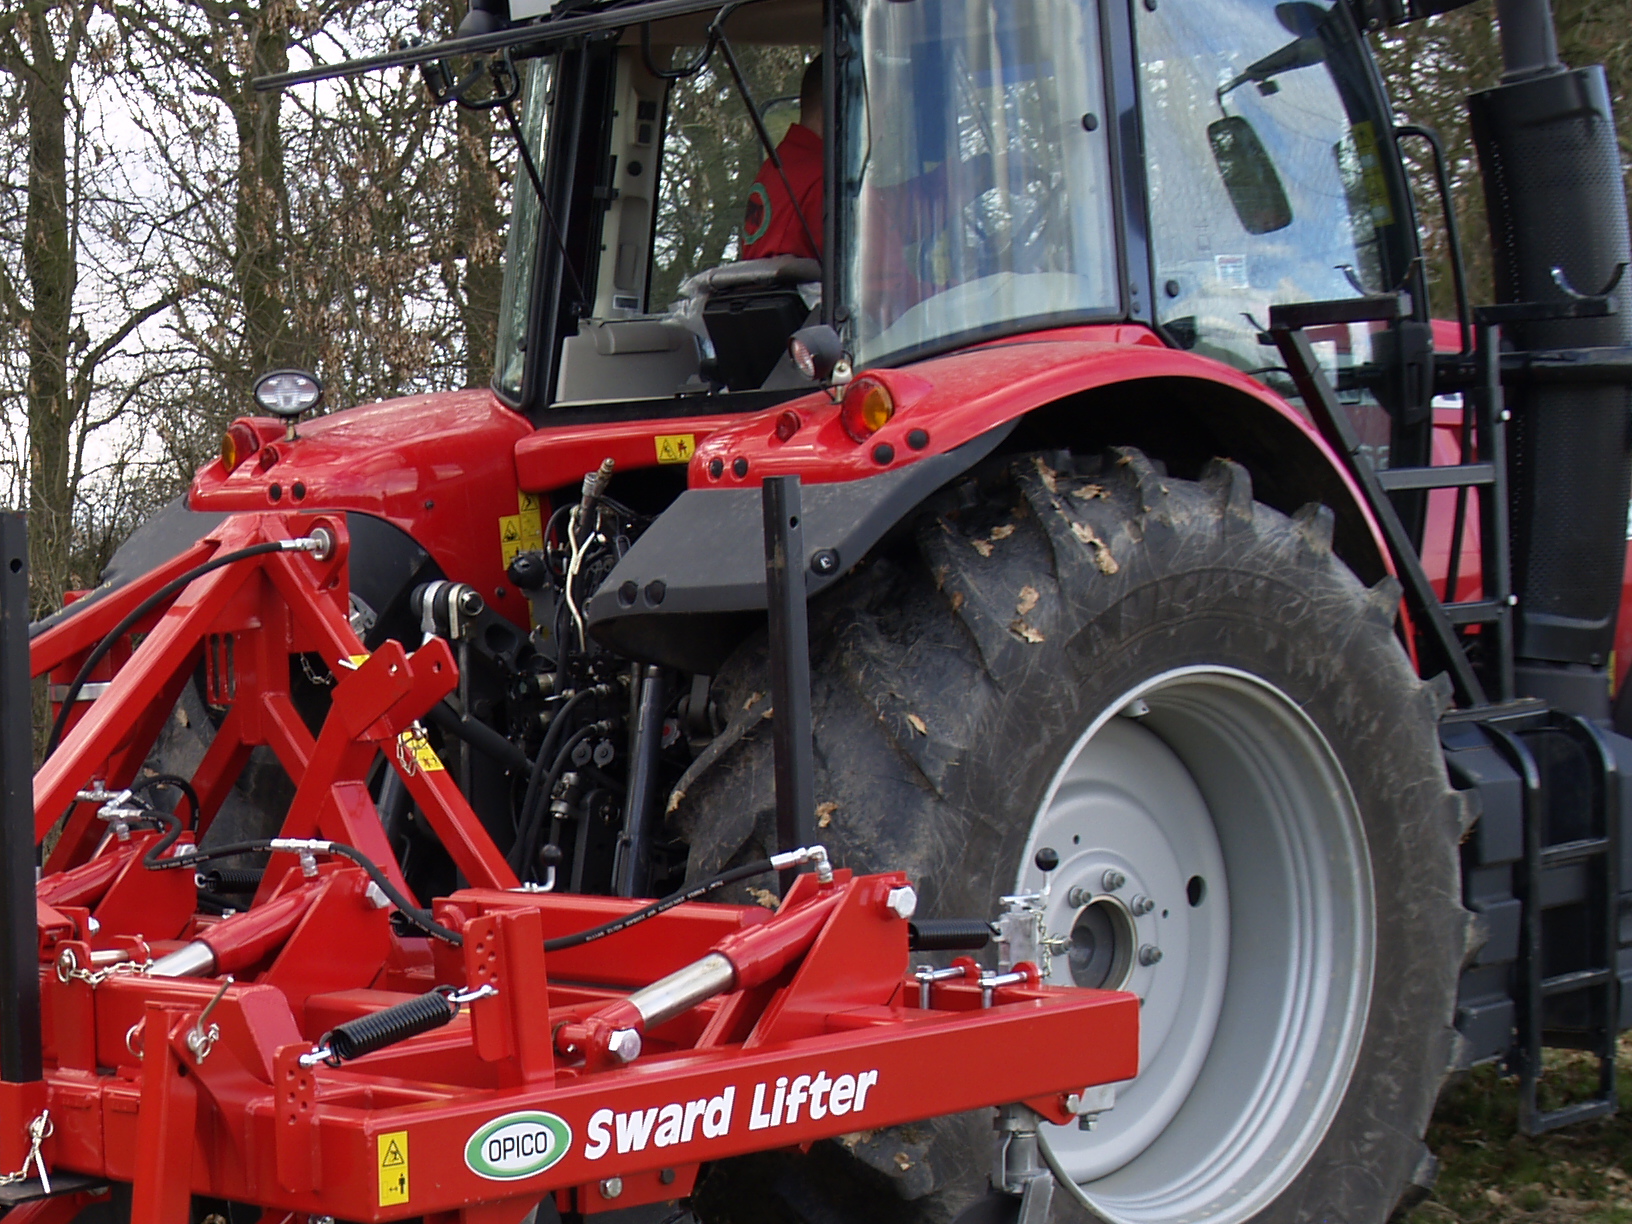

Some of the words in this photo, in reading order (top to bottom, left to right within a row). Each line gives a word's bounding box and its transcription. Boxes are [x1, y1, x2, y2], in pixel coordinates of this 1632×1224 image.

[584, 1086, 736, 1160] Sward
[748, 1069, 878, 1131] Lifter
[488, 1131, 548, 1162] OPICO
